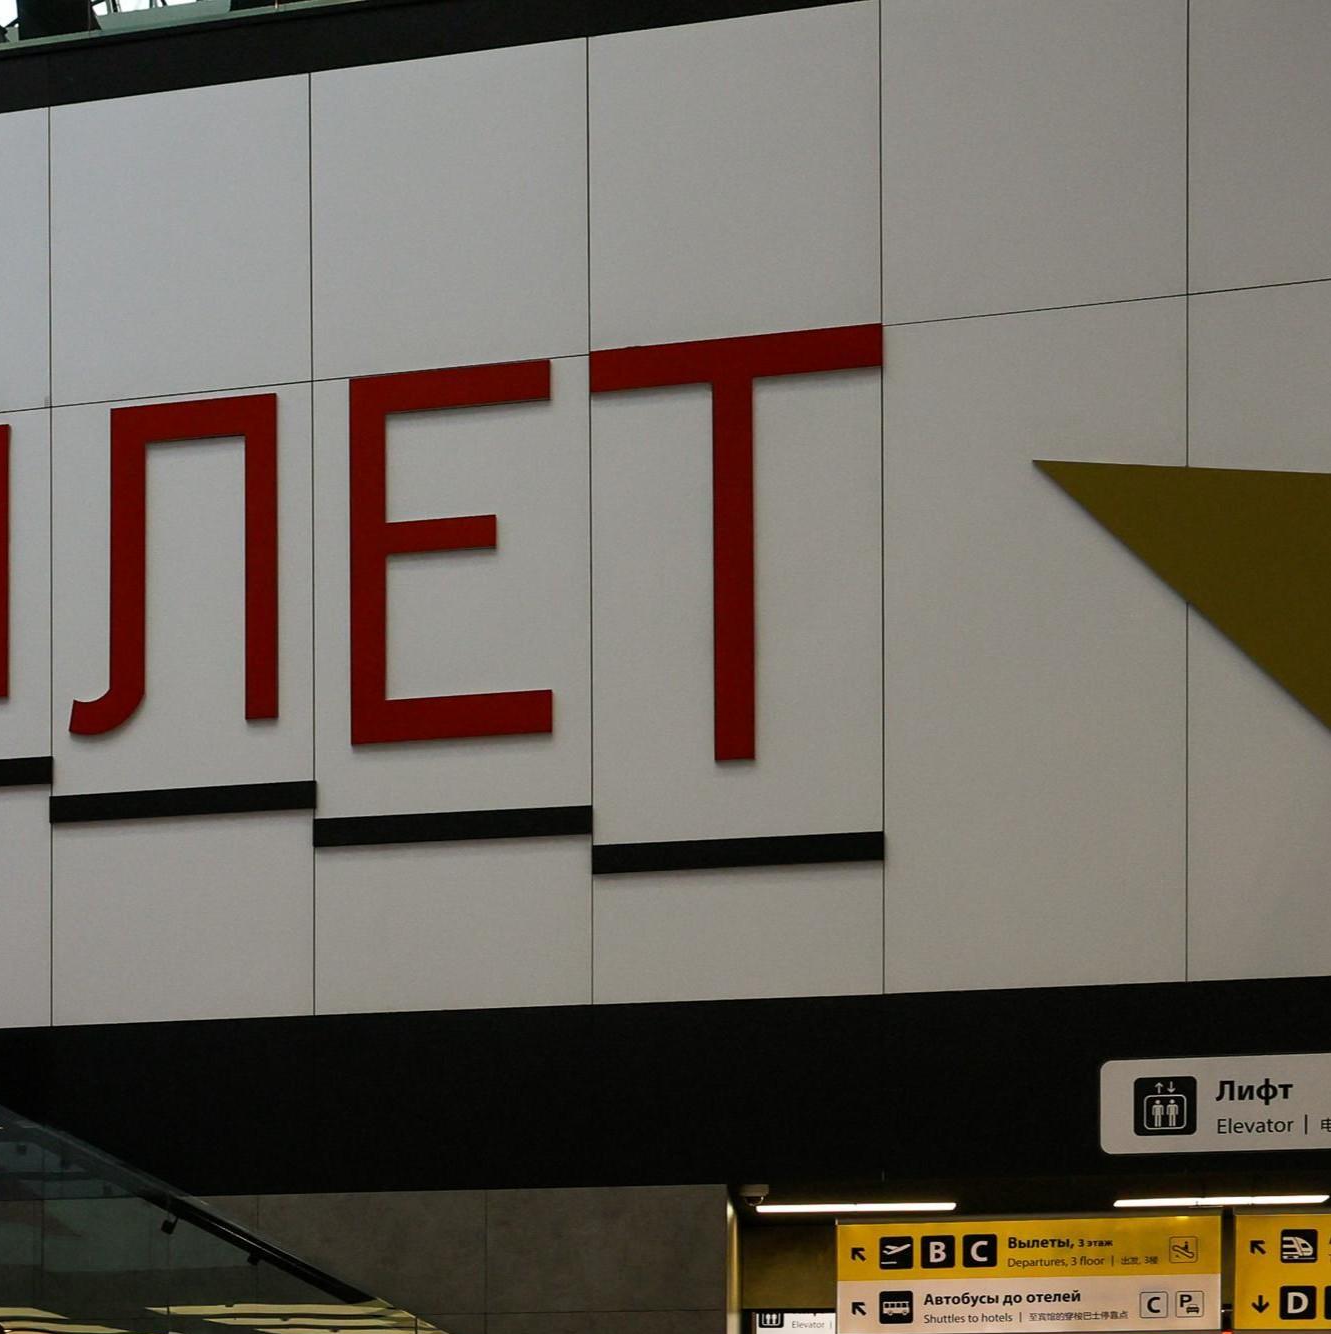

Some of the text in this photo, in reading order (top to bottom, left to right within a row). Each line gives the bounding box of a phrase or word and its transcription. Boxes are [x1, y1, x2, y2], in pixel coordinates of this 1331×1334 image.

[1215, 1078, 1294, 1106] Лифт
[1216, 1117, 1294, 1134] Elevator
[929, 1240, 988, 1263] B C
[1007, 1237, 1113, 1250] Вылеты, 3 этаж
[1007, 1255, 1105, 1269] Departures, 3 floor
[923, 1290, 1081, 1307] Автобусы до отелей
[1146, 1296, 1161, 1314] C
[1179, 1294, 1192, 1308] P
[1287, 1292, 1309, 1314] D
[923, 1312, 1013, 1324] Shuttles to hotels
